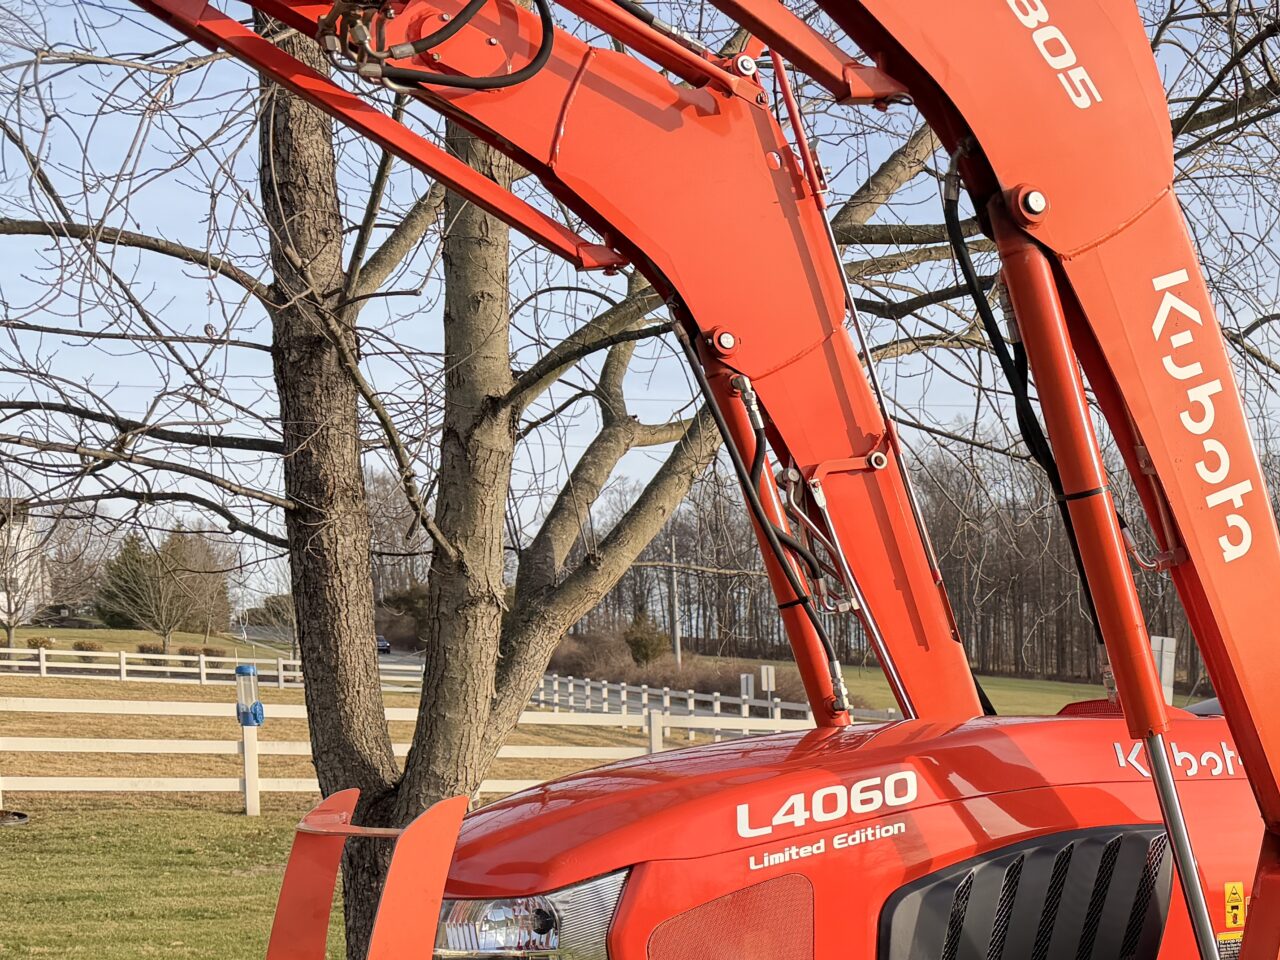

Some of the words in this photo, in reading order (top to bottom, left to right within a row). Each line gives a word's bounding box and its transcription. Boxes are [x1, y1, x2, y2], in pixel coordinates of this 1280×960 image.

[1151, 268, 1253, 563] Kubota
[1113, 742, 1243, 777] Kbot
[737, 771, 918, 838] L4060
[749, 839, 825, 870] Limited
[833, 822, 906, 849] Edition
